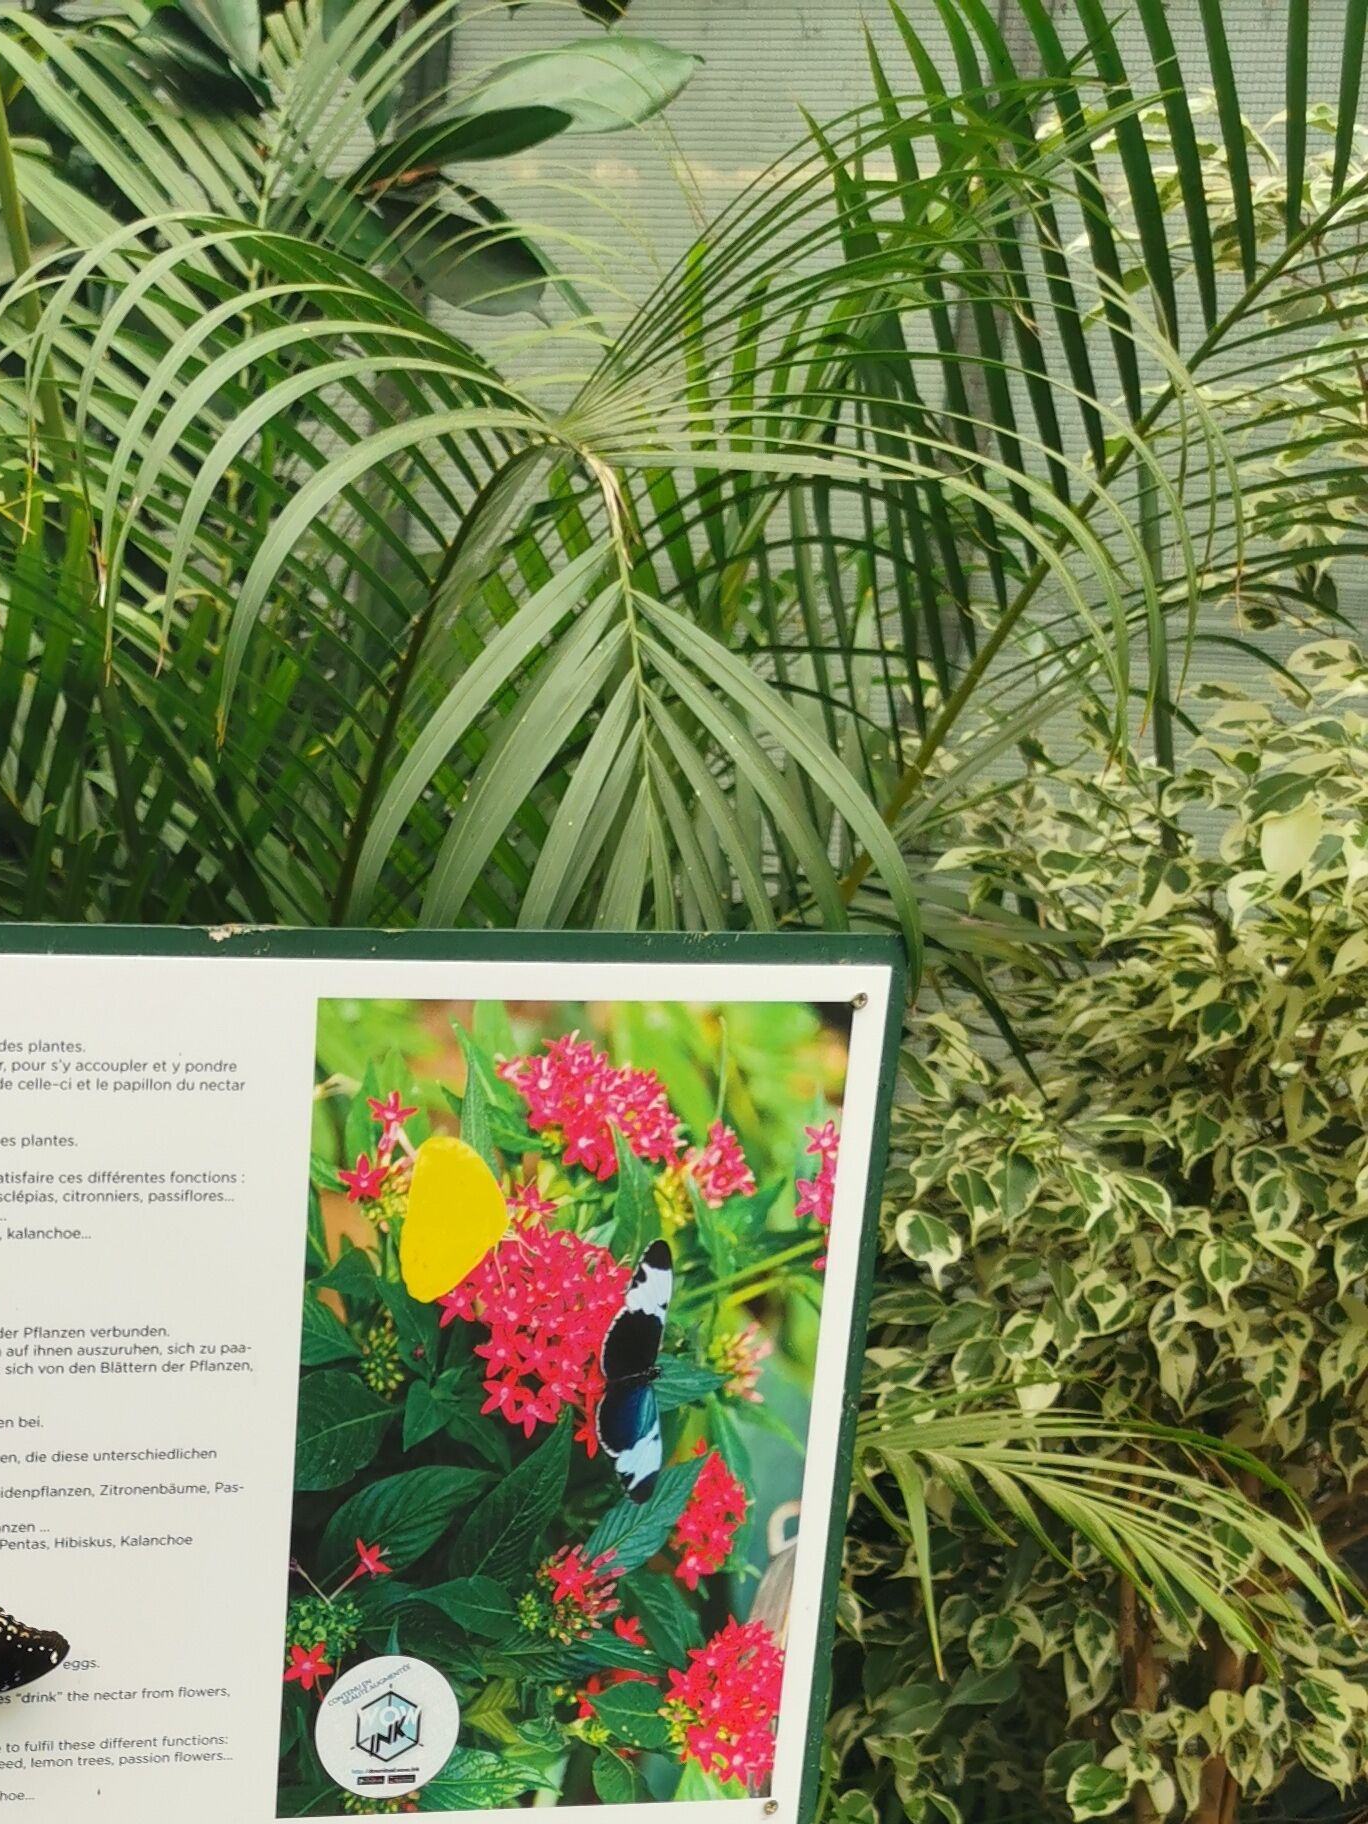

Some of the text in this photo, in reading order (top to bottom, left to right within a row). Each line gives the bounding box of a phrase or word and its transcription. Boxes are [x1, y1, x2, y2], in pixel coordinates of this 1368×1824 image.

[27, 1039, 86, 1055] plantes.
[10, 1060, 47, 1073] pour
[50, 1058, 71, 1074] s'y
[74, 1058, 149, 1074] accoupler
[152, 1060, 167, 1072] et
[171, 1061, 181, 1075] y
[184, 1059, 238, 1074] pondre
[20, 1133, 78, 1149] plantes.
[22, 1325, 86, 1339] Pflanzen
[89, 1324, 170, 1338] verbunden.
[18, 1415, 44, 1428] bei.
[24, 1450, 47, 1463] die
[50, 1449, 89, 1463] diese
[92, 1447, 217, 1462] unterschiedlichen
[54, 1535, 116, 1549] Hibiskus,
[120, 1533, 193, 1547] Kalanchoe
[62, 1658, 101, 1671] eggs.
[15, 1691, 63, 1704] “drink”
[66, 1690, 90, 1702] the
[92, 1689, 138, 1701] nectar
[141, 1687, 175, 1699] from
[177, 1686, 231, 1698] flowers,
[356, 1705, 422, 1729] WOW
[369, 1715, 406, 1757] INK
[30, 1756, 74, 1768] lemon
[77, 1755, 115, 1766] trees,
[118, 1752, 170, 1767] passion
[174, 1751, 233, 1762] flowers...
